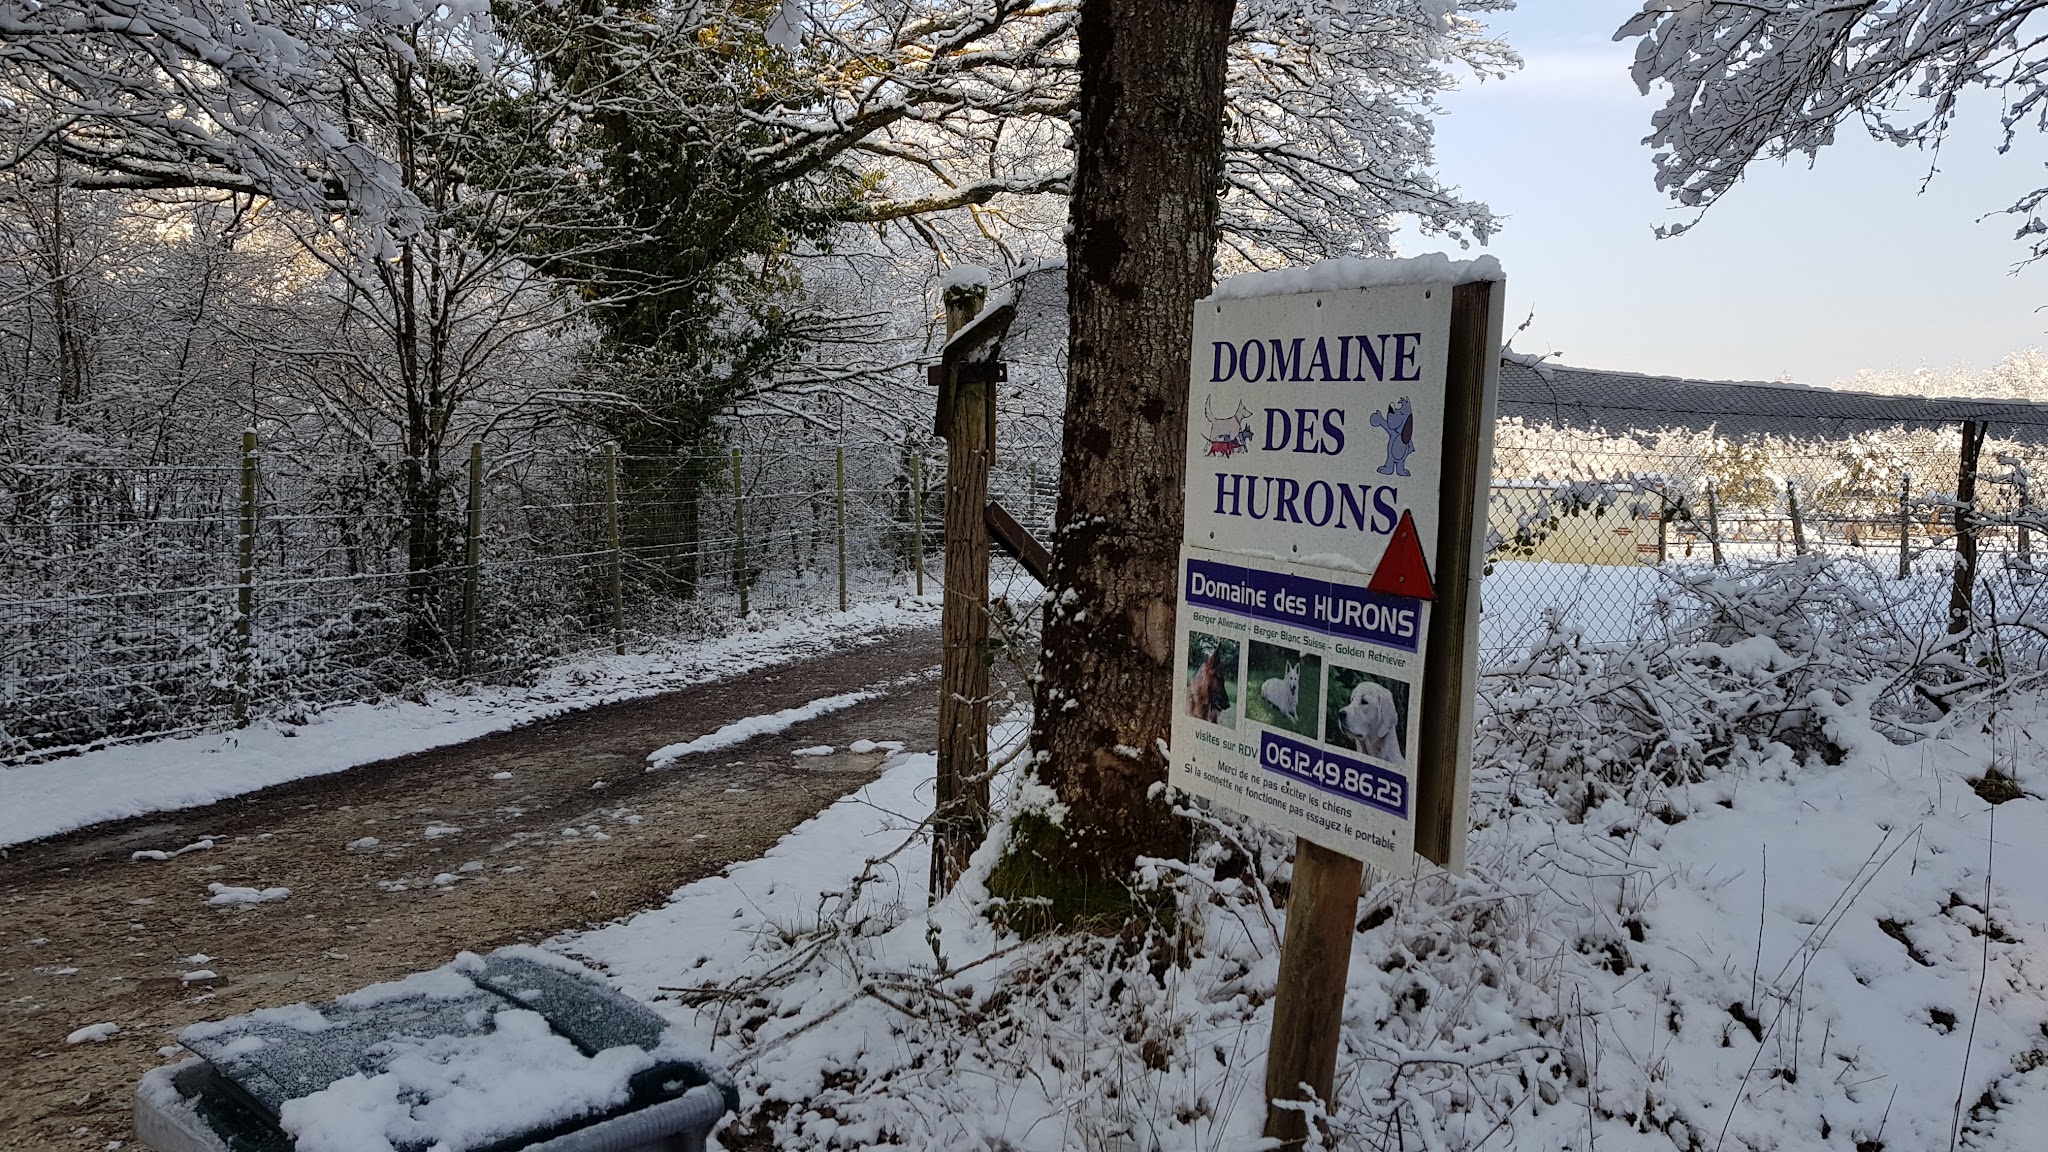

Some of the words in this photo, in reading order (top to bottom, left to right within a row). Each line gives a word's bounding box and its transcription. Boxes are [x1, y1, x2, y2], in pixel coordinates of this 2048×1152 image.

[1210, 333, 1421, 382] DOMAINE
[1262, 408, 1345, 455] DES
[1214, 473, 1398, 534] HURONS
[1191, 571, 1267, 608] Domaine
[1273, 588, 1307, 616] des
[1314, 594, 1415, 638] HURONS
[1193, 611, 1217, 625] Berger
[1218, 616, 1246, 631] Allemand
[1253, 625, 1279, 639] Berger
[1280, 630, 1301, 644] Blanc
[1303, 635, 1326, 650] Suisse
[1335, 643, 1365, 659] Golden
[1368, 650, 1406, 668] Retriever
[1195, 729, 1220, 746] visites
[1222, 740, 1236, 751] sur
[1238, 743, 1258, 758] RDV
[1217, 760, 1238, 776] Merci
[1239, 769, 1249, 780] de
[1251, 775, 1260, 785] ne
[1263, 778, 1278, 791] pas
[1280, 784, 1307, 801] exciter
[1309, 793, 1319, 806] les
[1322, 800, 1352, 818] chiens
[1265, 742, 1402, 807] 06.12.49.86.23
[1184, 763, 1192, 774] Si
[1194, 766, 1201, 777] la
[1203, 771, 1233, 790] sonnette
[1234, 783, 1243, 793] ne
[1245, 787, 1287, 810] fonctionne
[1289, 805, 1304, 817] pas
[1306, 811, 1341, 832] essayez
[1344, 823, 1352, 836] le
[1355, 828, 1396, 852] portable
